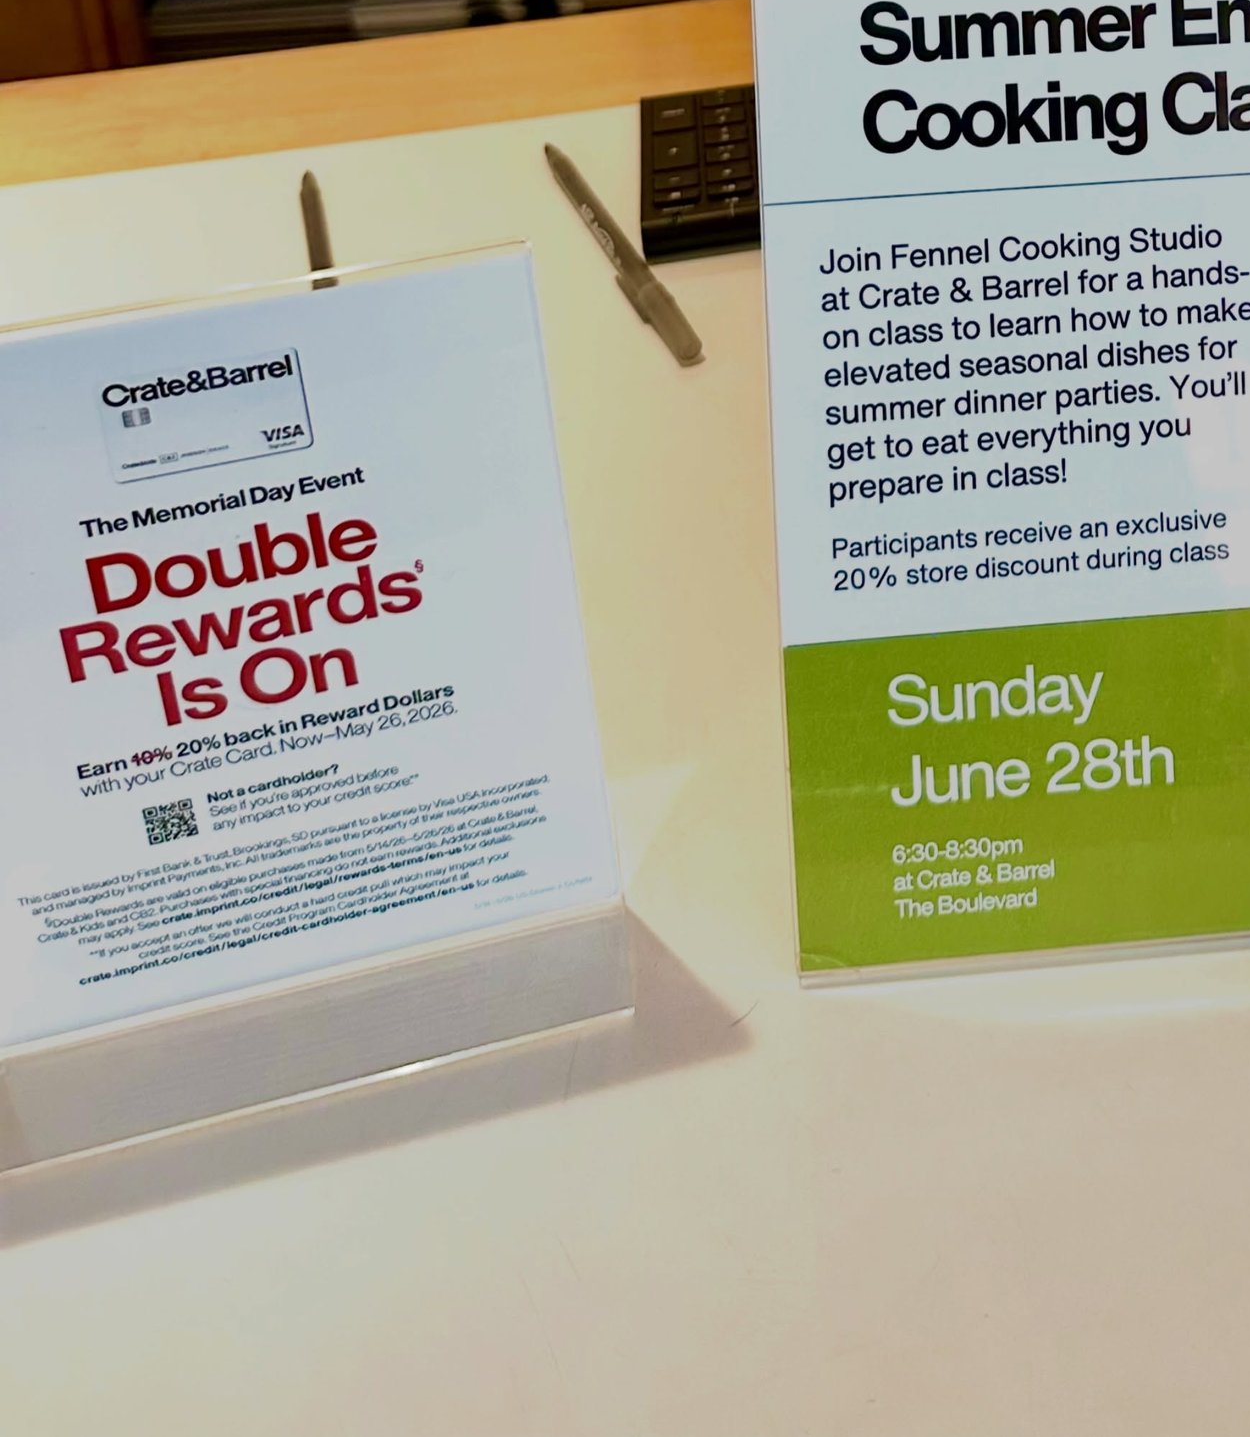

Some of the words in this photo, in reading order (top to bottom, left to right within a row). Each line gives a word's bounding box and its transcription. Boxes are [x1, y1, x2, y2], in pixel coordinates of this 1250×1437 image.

[859, 0, 1157, 66] Summer
[862, 80, 1149, 156] Cooking
[819, 246, 881, 275] Join
[891, 237, 990, 270] Fennel
[999, 231, 1121, 262] Cooking
[1129, 223, 1223, 254] Studio
[821, 286, 850, 313] at
[858, 281, 940, 310] Crate
[949, 277, 973, 304] &
[982, 270, 1069, 301] Barrel
[1077, 268, 1119, 294] for
[1126, 271, 1144, 292] a
[1152, 260, 1250, 289] hands-
[822, 328, 860, 350] on
[868, 320, 944, 347] class
[951, 316, 981, 341] to
[989, 312, 1061, 338] learn
[1070, 307, 1131, 332] how
[1138, 303, 1168, 328] to
[101, 354, 294, 408] Crate&Barrel
[824, 353, 950, 388] elevated
[959, 344, 1088, 378] seasonal
[1097, 339, 1190, 368] dishes
[1197, 335, 1238, 361] for
[825, 397, 946, 426] summer
[954, 389, 1047, 416] dinner
[1055, 379, 1161, 415] parties.
[261, 424, 305, 442] VISA
[827, 435, 876, 470] get
[883, 434, 913, 459] to
[922, 428, 969, 456] eat
[977, 418, 1130, 454] everything
[1138, 417, 1191, 446] you
[78, 517, 129, 538] The
[131, 489, 247, 529] Memorial
[249, 483, 295, 505] Day
[298, 467, 365, 496] Event
[829, 473, 944, 508] prepare
[952, 465, 977, 491] in
[986, 457, 1067, 489] class!
[832, 528, 978, 559] Participants
[985, 521, 1073, 547] receive
[1079, 521, 1108, 539] an
[1115, 509, 1227, 536] exclusive
[85, 512, 378, 615] Double
[834, 565, 897, 592] 20%
[906, 564, 968, 585] store
[975, 551, 1080, 579] discount
[1086, 545, 1162, 571] during
[1169, 541, 1230, 563] class
[156, 671, 228, 727] Is
[239, 647, 359, 705] On
[887, 664, 1104, 727] Sunday
[76, 759, 128, 780] Earn
[176, 734, 222, 758] 20%
[223, 723, 277, 747] back
[278, 719, 298, 735] in
[300, 698, 380, 730] Reward
[382, 685, 455, 711] Dollars
[80, 777, 122, 798] with
[123, 768, 166, 792] your
[169, 756, 223, 777] Crate
[225, 741, 277, 765] Card.
[206, 789, 234, 804] Not
[236, 787, 246, 797] a
[247, 763, 339, 794] cardholder?
[209, 804, 238, 817] See
[239, 799, 247, 810] if
[291, 774, 355, 799] approved
[356, 766, 399, 783] before
[890, 754, 1031, 807] June
[1046, 735, 1175, 794] 28th
[212, 818, 237, 831] any
[239, 805, 286, 825] impact
[286, 803, 302, 814] to
[303, 795, 331, 812] your
[333, 785, 372, 803] credit
[892, 837, 1024, 866] 6:30-8:30pm
[893, 872, 914, 893] at
[916, 868, 972, 891] Crate
[975, 864, 994, 885] &
[996, 859, 1056, 883] Barrel
[894, 898, 935, 919] The
[937, 887, 1038, 915] Boulevard
